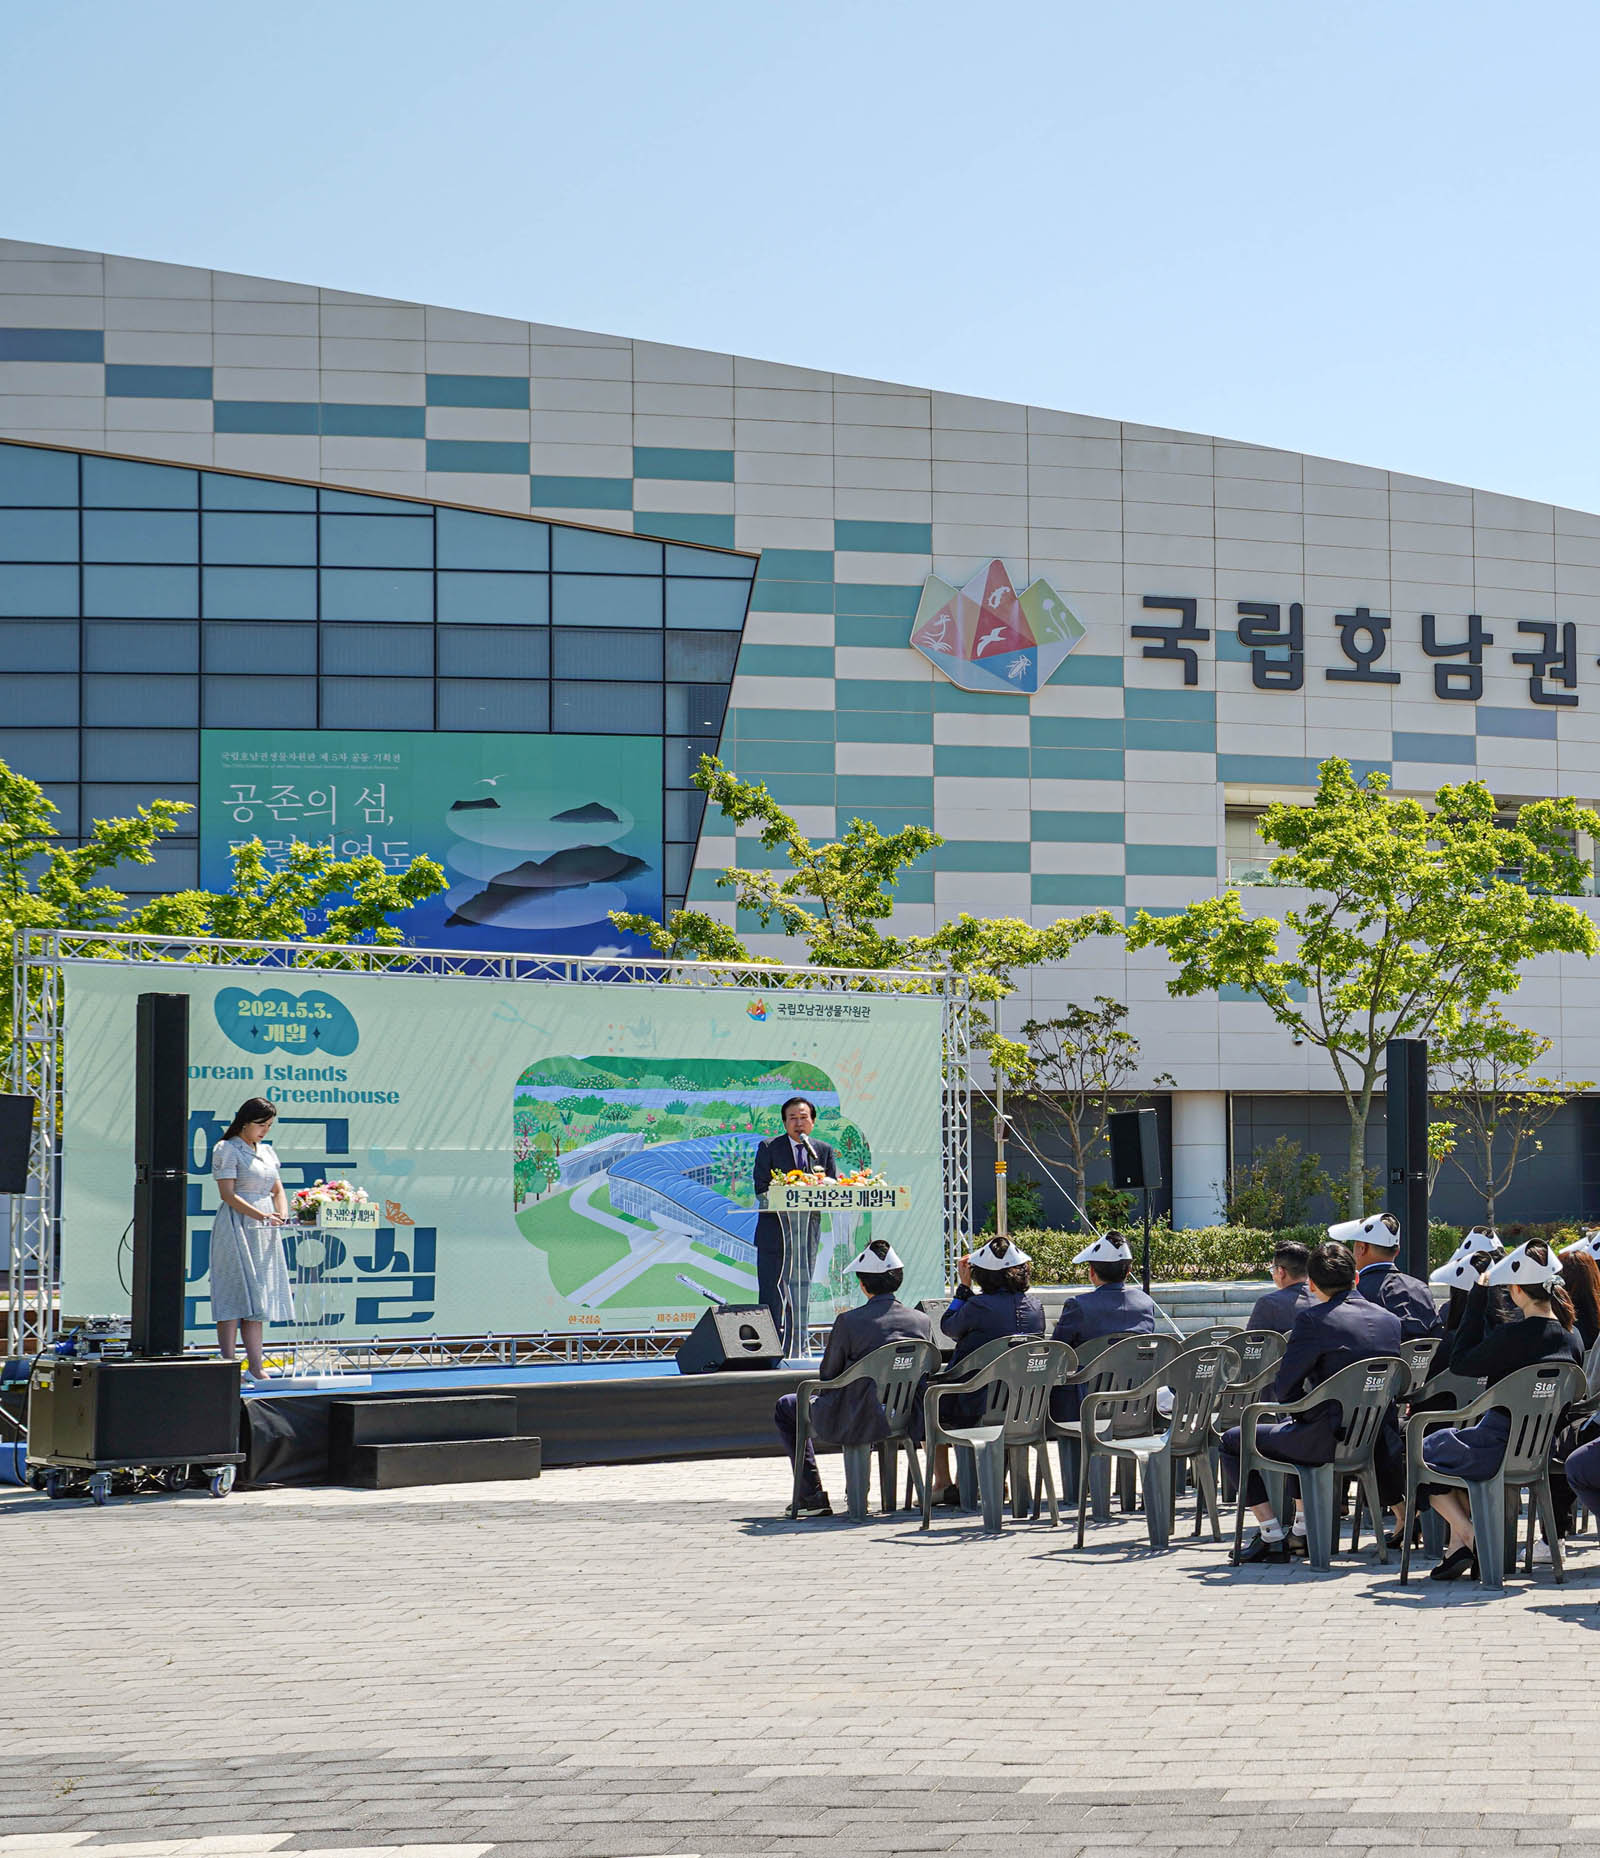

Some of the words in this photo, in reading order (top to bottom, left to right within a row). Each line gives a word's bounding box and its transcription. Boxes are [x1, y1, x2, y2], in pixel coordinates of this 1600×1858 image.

[221, 783, 337, 825] 공존의
[354, 783, 394, 825] 섬,
[238, 1000, 333, 1019] 2024.5.3.
[777, 1003, 871, 1018] 국립호남권생물자원관
[263, 1024, 307, 1044] 개원
[188, 1065, 254, 1081] orean
[264, 1064, 348, 1082] Islands
[266, 1086, 400, 1104] Greenhouse
[786, 1189, 853, 1208] 한국섬온실
[856, 1189, 896, 1208] 개원식
[1028, 1358, 1048, 1366] Star
[1365, 1377, 1385, 1385] Star
[1535, 1382, 1556, 1391] Star
